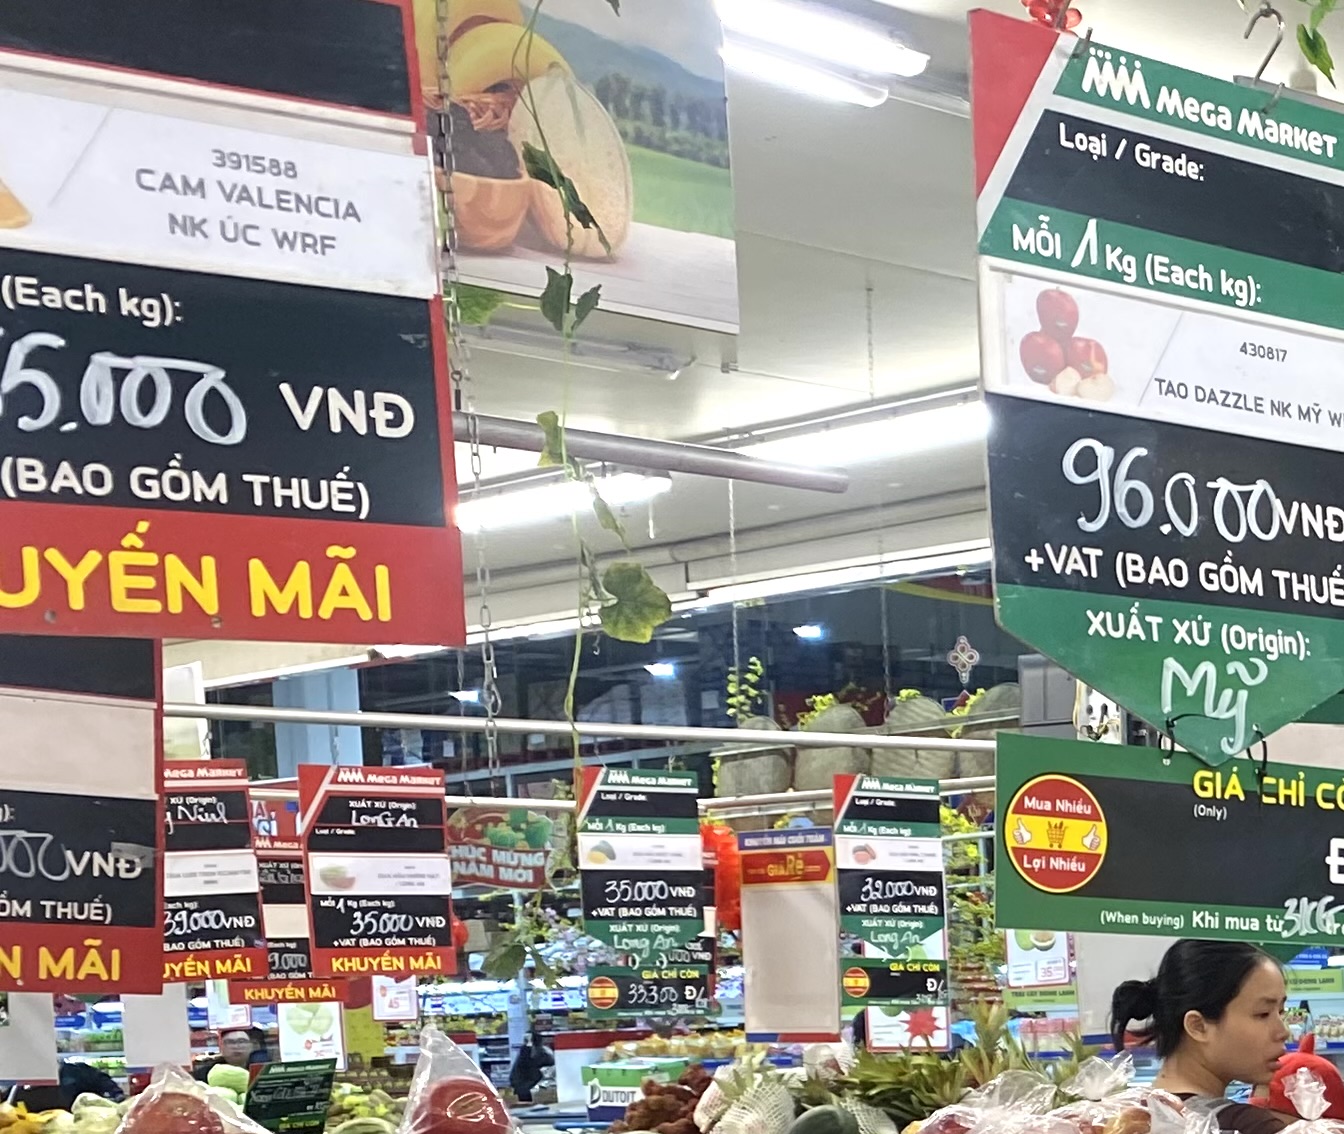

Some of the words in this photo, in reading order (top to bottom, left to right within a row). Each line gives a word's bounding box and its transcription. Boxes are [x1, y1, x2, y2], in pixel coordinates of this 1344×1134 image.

[211, 148, 298, 180] 391588
[1058, 122, 1107, 161] Loại
[1115, 139, 1126, 160] /
[1134, 143, 1204, 182] Grade:
[135, 168, 207, 201] CAM
[217, 180, 361, 223] VALENCIA
[169, 213, 208, 240] NK
[220, 212, 261, 248] ÚC
[270, 228, 337, 257] WRF
[1012, 215, 1061, 259] MỖI
[1105, 244, 1137, 283] Kg
[1144, 253, 1213, 293] (Each
[1221, 269, 1262, 307] kg):
[0, 275, 106, 315] (Each
[118, 285, 183, 328] kg):
[1240, 342, 1288, 363] 430817
[0, 328, 247, 446] 5.000
[279, 382, 416, 439] VNĐ
[1195, 385, 1265, 415] DAZZLE
[1270, 394, 1292, 419] NK
[1298, 394, 1322, 426] MỸ
[1, 455, 113, 499] (BAO
[129, 452, 229, 504] GỒM
[242, 465, 371, 520] THUẾ)
[249, 545, 392, 623] MÃI
[1025, 542, 1103, 581] +VAT
[1116, 551, 1188, 589] (BAO
[1200, 550, 1264, 597] GỒM
[1086, 602, 1163, 643] XUẤT
[1172, 614, 1212, 647] XỨ
[1222, 623, 1311, 661] (Origin):
[1161, 656, 1268, 755] Mỹ
[1193, 766, 1245, 802] GIÁ
[1024, 795, 1053, 813] Mua
[1055, 795, 1092, 816] Nhiều
[1193, 804, 1228, 821] (Only)
[66, 849, 142, 879] VNĐ
[1023, 855, 1046, 871] Lợi
[1050, 855, 1086, 873] Nhiều
[40, 893, 113, 924] THUẾ)
[223, 915, 255, 929] VNĐ
[416, 917, 446, 928] VNĐ
[1100, 909, 1139, 927] (When
[1142, 912, 1184, 929] buying)
[1192, 910, 1219, 931] Khi
[1225, 914, 1260, 932] mua
[39, 937, 120, 981] MÃI
[216, 955, 252, 975] MÃI
[332, 949, 404, 972] KHUYẾN
[410, 952, 442, 970] MÃI
[244, 982, 304, 1001] KHUYẾN
[309, 984, 336, 999] MÃI
